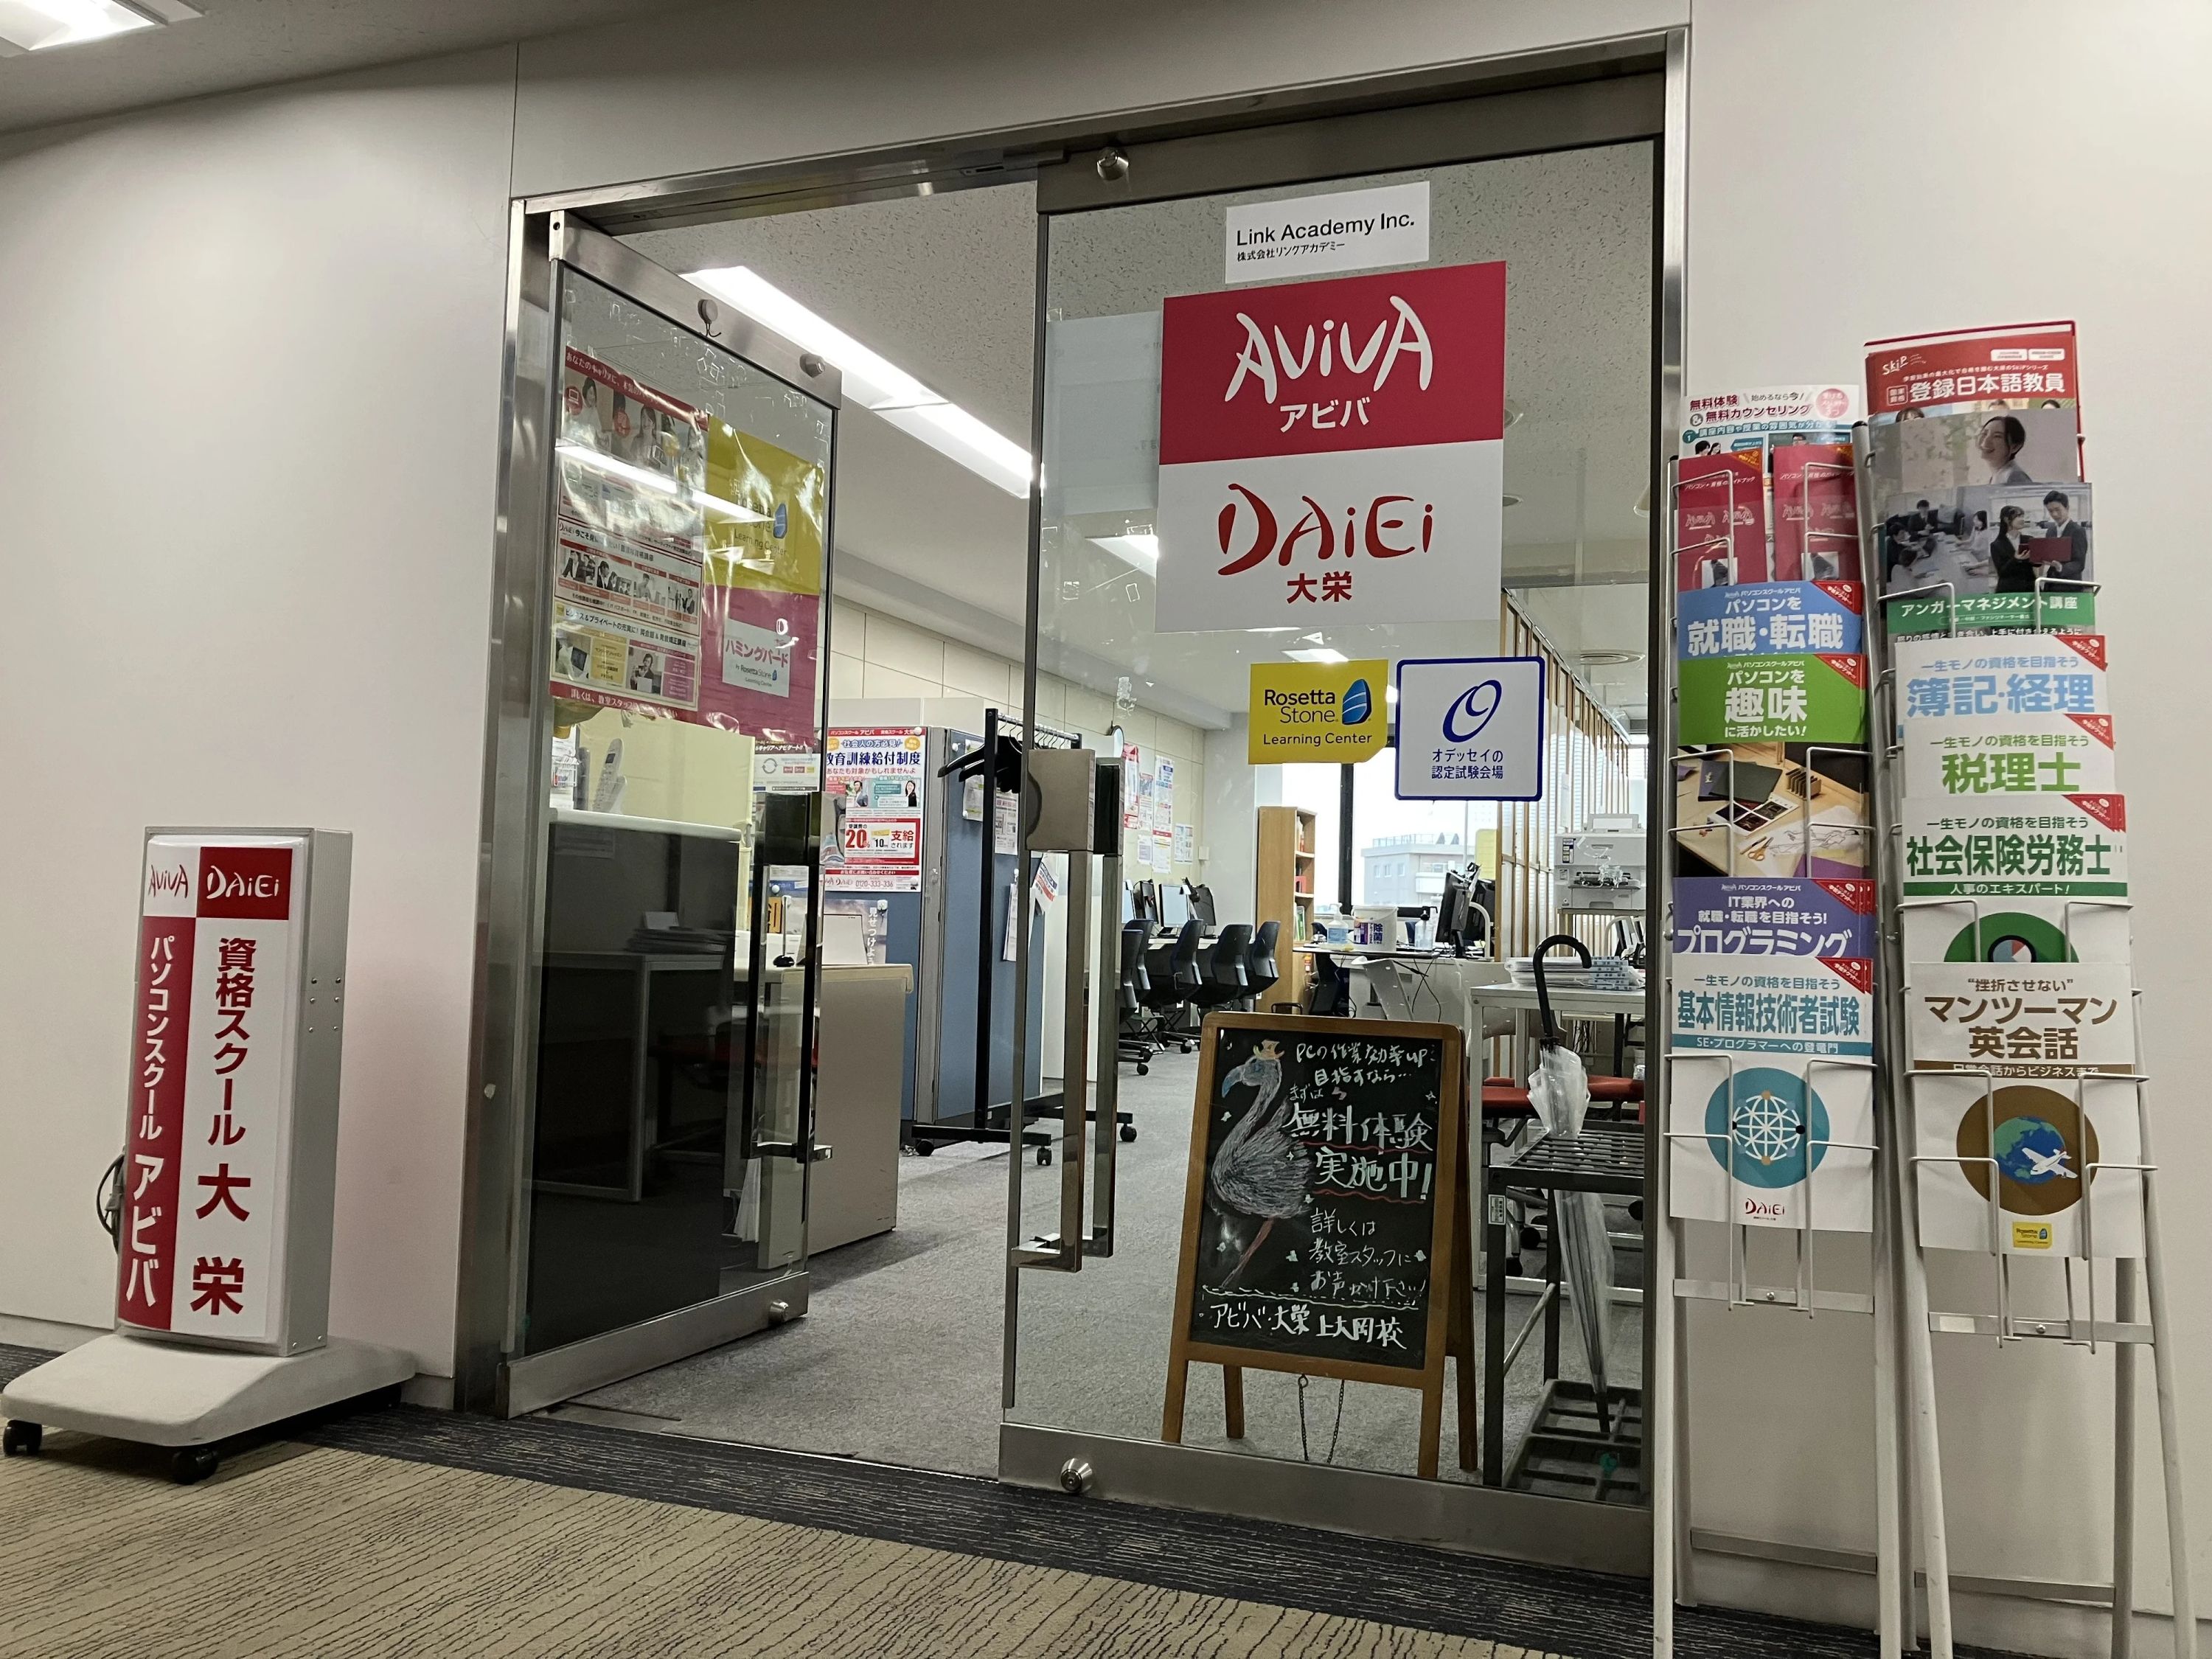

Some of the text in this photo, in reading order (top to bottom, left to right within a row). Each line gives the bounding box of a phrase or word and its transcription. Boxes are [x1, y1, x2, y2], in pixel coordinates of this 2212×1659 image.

[1237, 212, 1416, 246] Link Academy Inc.
[1237, 242, 1346, 262] 株式会社リンクアカデミー
[1689, 394, 1739, 411] 無料体験
[1910, 372, 2066, 403] 登録日本語教員
[1279, 396, 1371, 434] アビバ
[1705, 403, 1812, 423] 無料カウンセリング
[1286, 571, 1353, 605] 大栄
[1725, 597, 1802, 614] パソコンを
[1902, 595, 2079, 618] アンガーマネジメント講座
[1687, 613, 1844, 657] 就職・転職
[726, 639, 790, 668] ハミングバード
[1921, 655, 2079, 672] 一生モノの資格を目指そう
[1728, 669, 1805, 686] パソコンを
[1264, 689, 1335, 706] Rosetta
[1725, 686, 1807, 723] 趣味
[1906, 672, 2096, 718] 簿記・経理
[1263, 731, 1373, 747] Learning Center
[1725, 726, 1806, 738] に活かしたい!
[1930, 734, 2090, 748] 一生モノの資格を目指そう
[1431, 748, 1504, 763] オデッセイの
[1431, 765, 1504, 780] 認定試験会場
[1941, 751, 2081, 795] 税理士
[891, 830, 914, 842] 支給
[1927, 815, 2089, 830] 一生モノの資格を目指そう
[1906, 834, 2112, 877] 社会保険労務士
[1728, 896, 1795, 909] IT業界への
[1950, 883, 2070, 895] 人事のエキスパート!
[1698, 910, 1828, 925] 就職・転職を目指そう!
[1677, 925, 1853, 958] プログラミング
[1694, 974, 1841, 990] 一生モノの資格を目指そう
[1677, 990, 1860, 1036] 基本情報技術者試験
[1924, 996, 2118, 1026] マンツーマン
[139, 934, 175, 1141] パソコンスクール
[206, 936, 257, 1147] 資格スクール
[1968, 1026, 2079, 1060] 英会話
[1281, 1102, 1433, 1155] 無料体験
[1314, 1145, 1433, 1201] 実施中!
[125, 1152, 165, 1307] アビバ
[1310, 1207, 1377, 1237] 詳しくは
[189, 1161, 251, 1316] 大栄
[1309, 1237, 1412, 1267] 教室スタッフに
